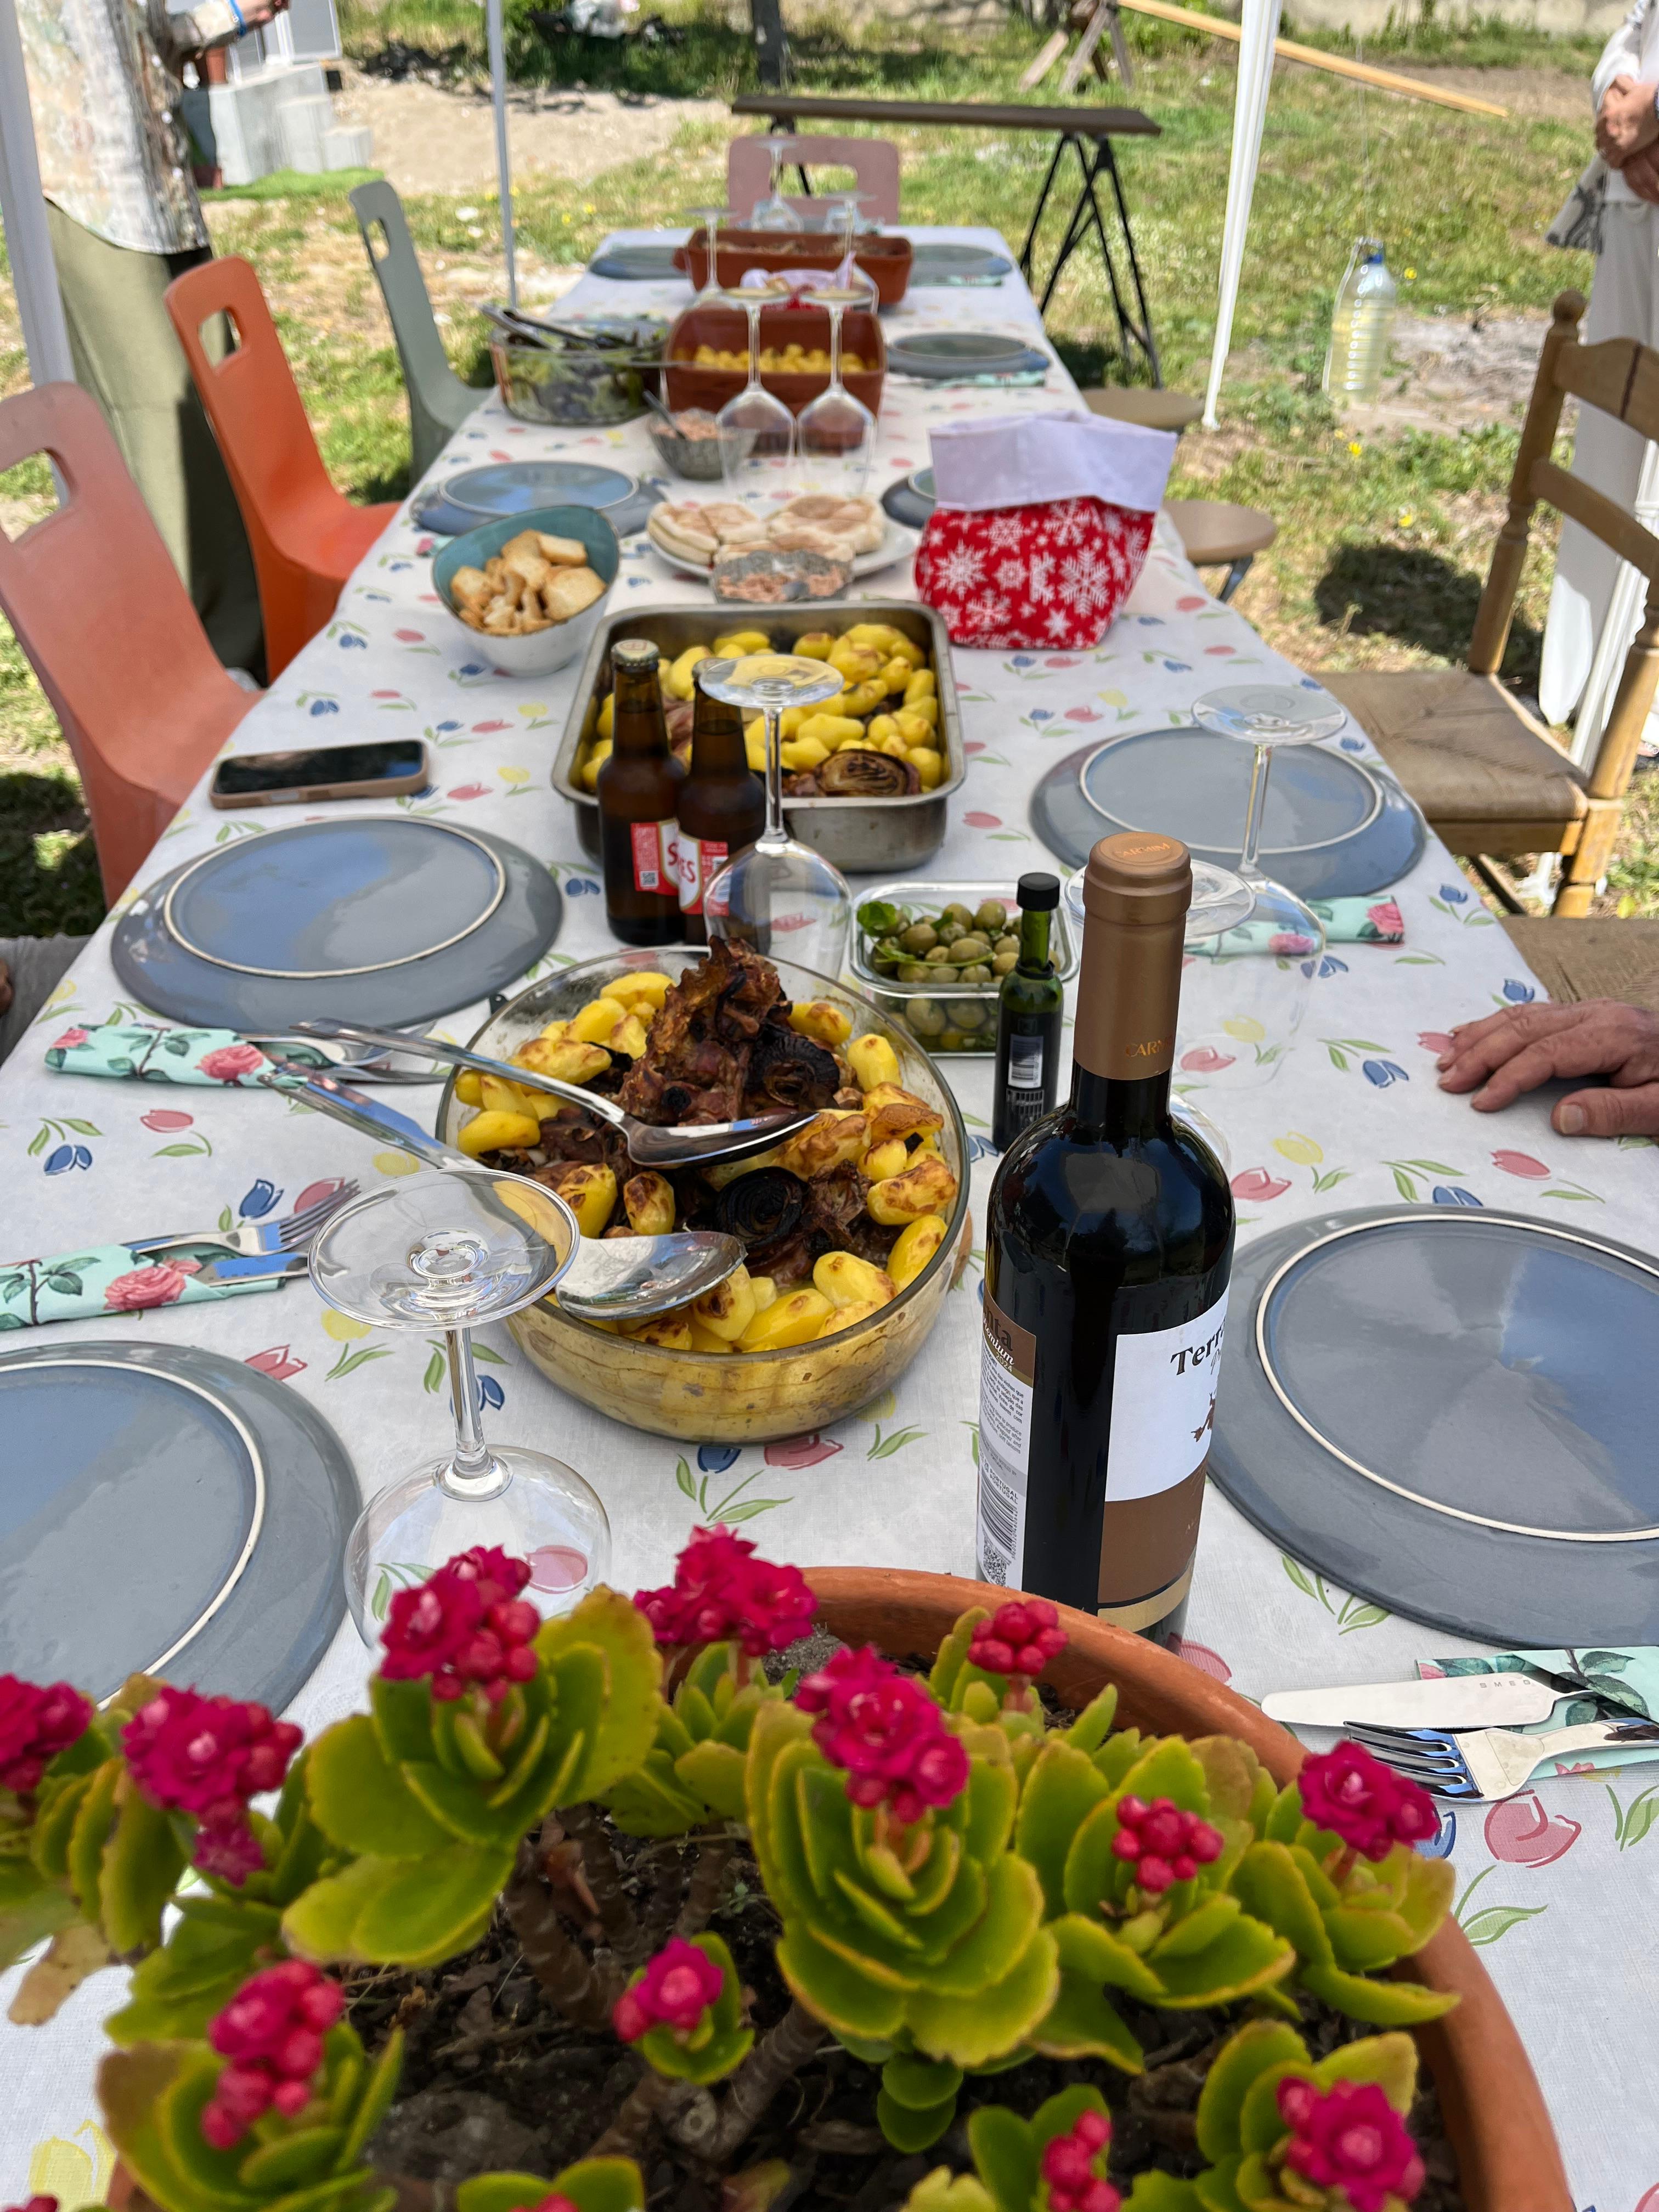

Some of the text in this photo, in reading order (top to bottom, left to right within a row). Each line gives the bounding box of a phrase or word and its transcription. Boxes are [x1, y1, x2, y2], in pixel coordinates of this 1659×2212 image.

[996, 1352, 1013, 1372] 2024
[1012, 1394, 1020, 1402] que
[1015, 1403, 1023, 1411] das
[1013, 1415, 1023, 1424] com
[1006, 1421, 1022, 1436] produce
[1013, 1440, 1022, 1448] and
[990, 1468, 1018, 1500] PORTUGAL
[1479, 1679, 1531, 1688] SMEG
